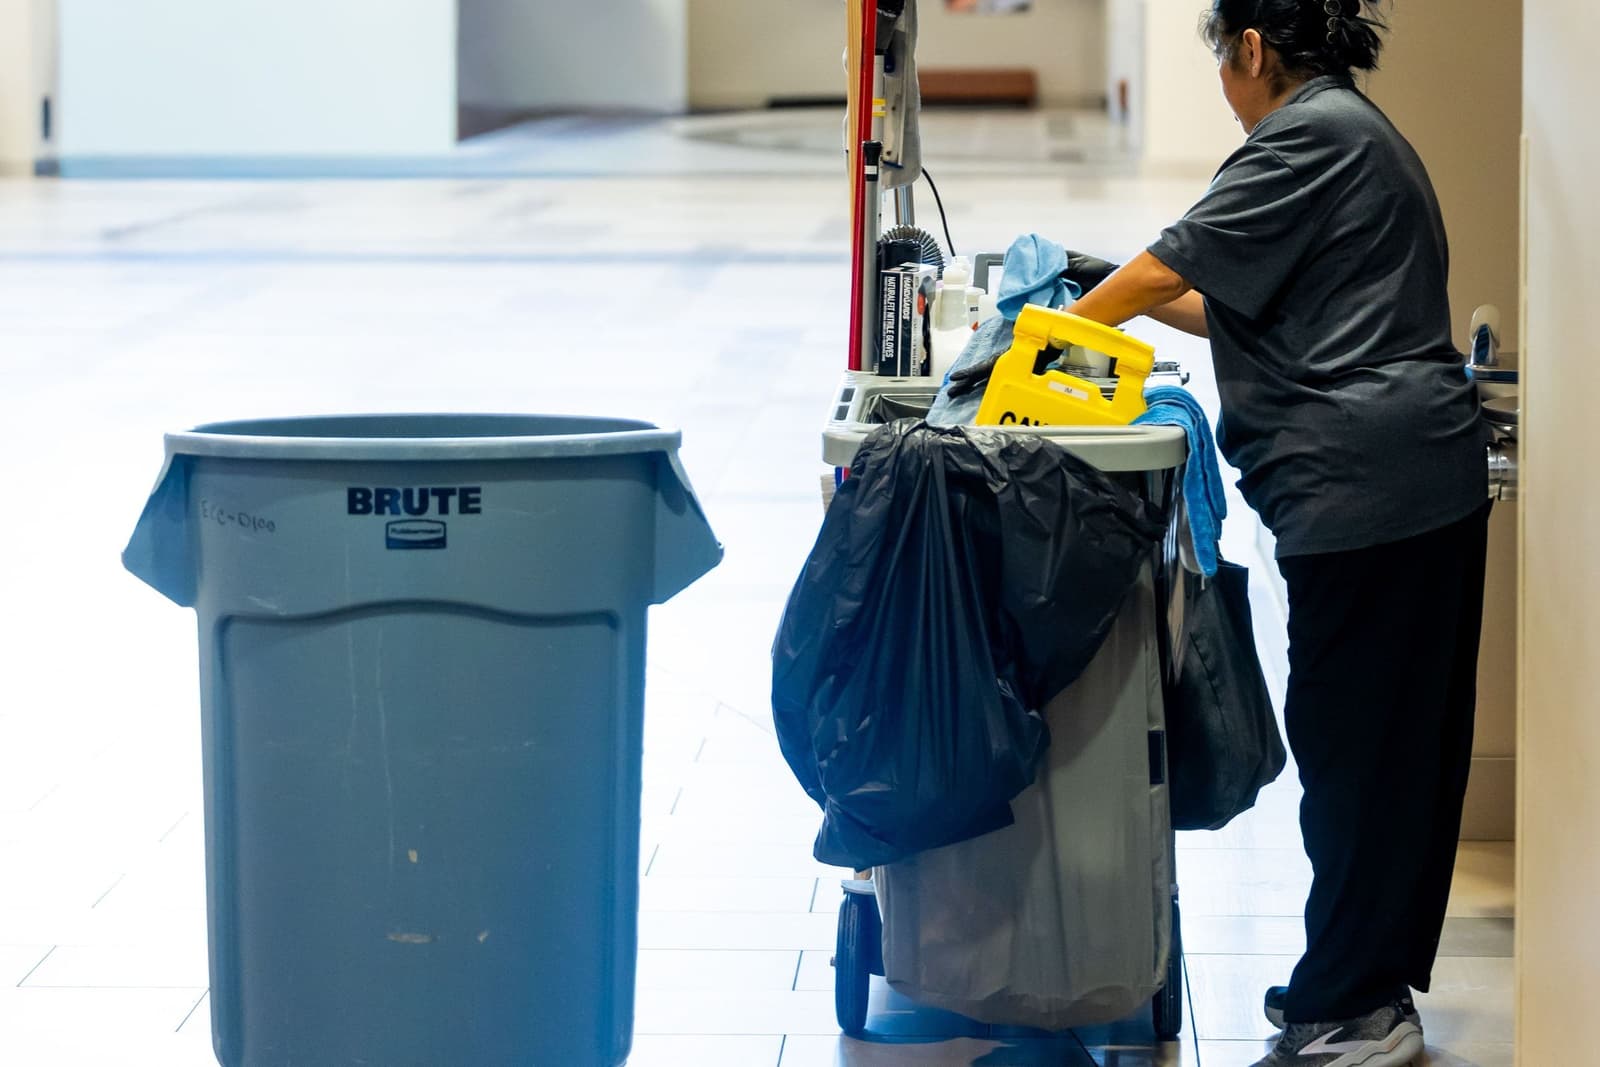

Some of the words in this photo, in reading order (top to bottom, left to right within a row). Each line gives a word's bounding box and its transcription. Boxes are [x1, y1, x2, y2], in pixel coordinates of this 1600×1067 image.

[886, 312, 895, 334] NITRILE
[885, 335, 894, 358] GLOVES
[347, 487, 482, 516] BRUTE
